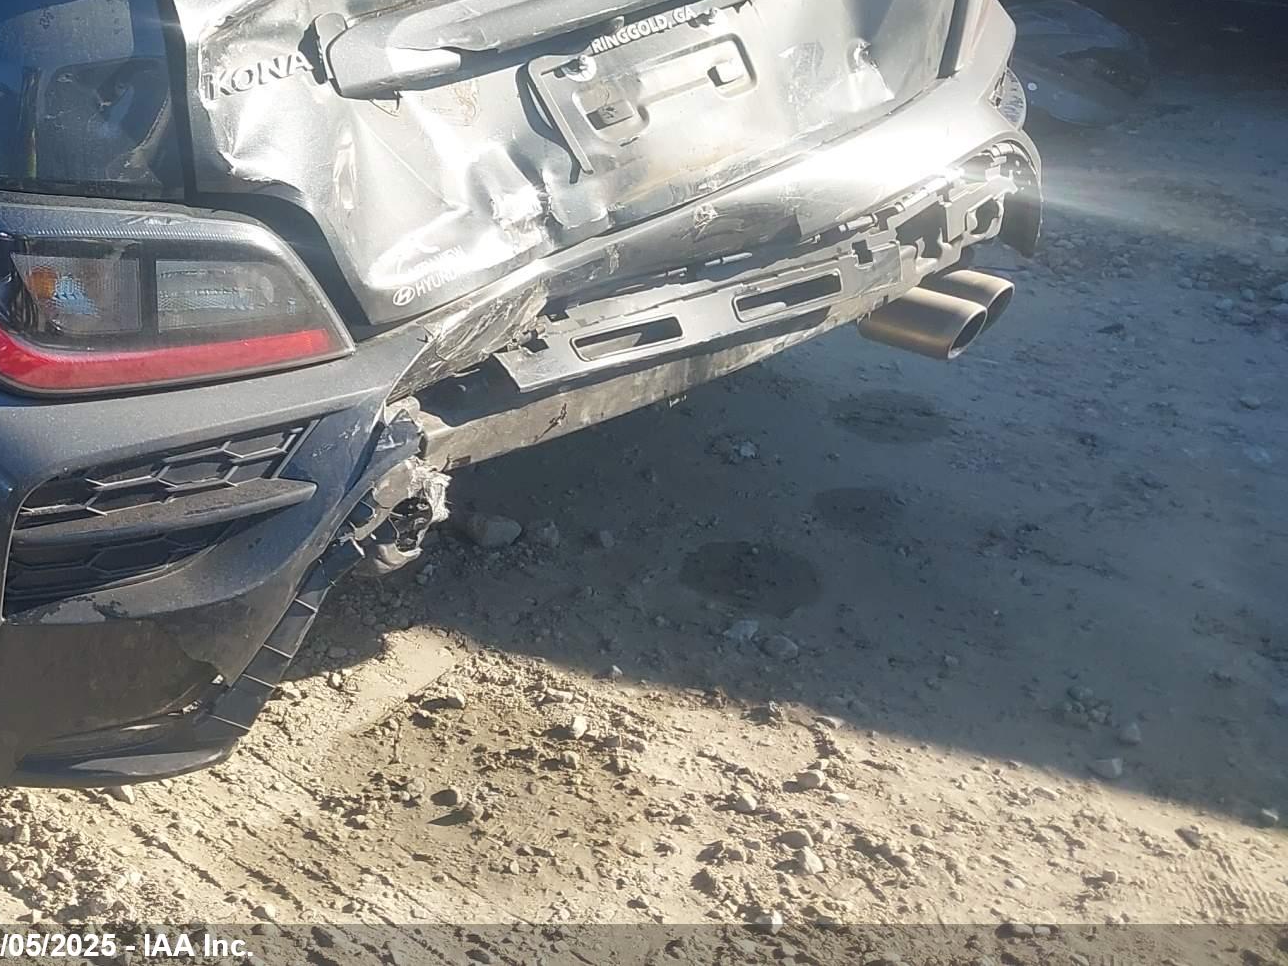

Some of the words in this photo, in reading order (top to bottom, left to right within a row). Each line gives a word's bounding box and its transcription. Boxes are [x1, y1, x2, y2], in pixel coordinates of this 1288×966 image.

[590, 14, 673, 54] RINGGOLD,
[672, 4, 698, 24] GA
[206, 52, 314, 101] KONA
